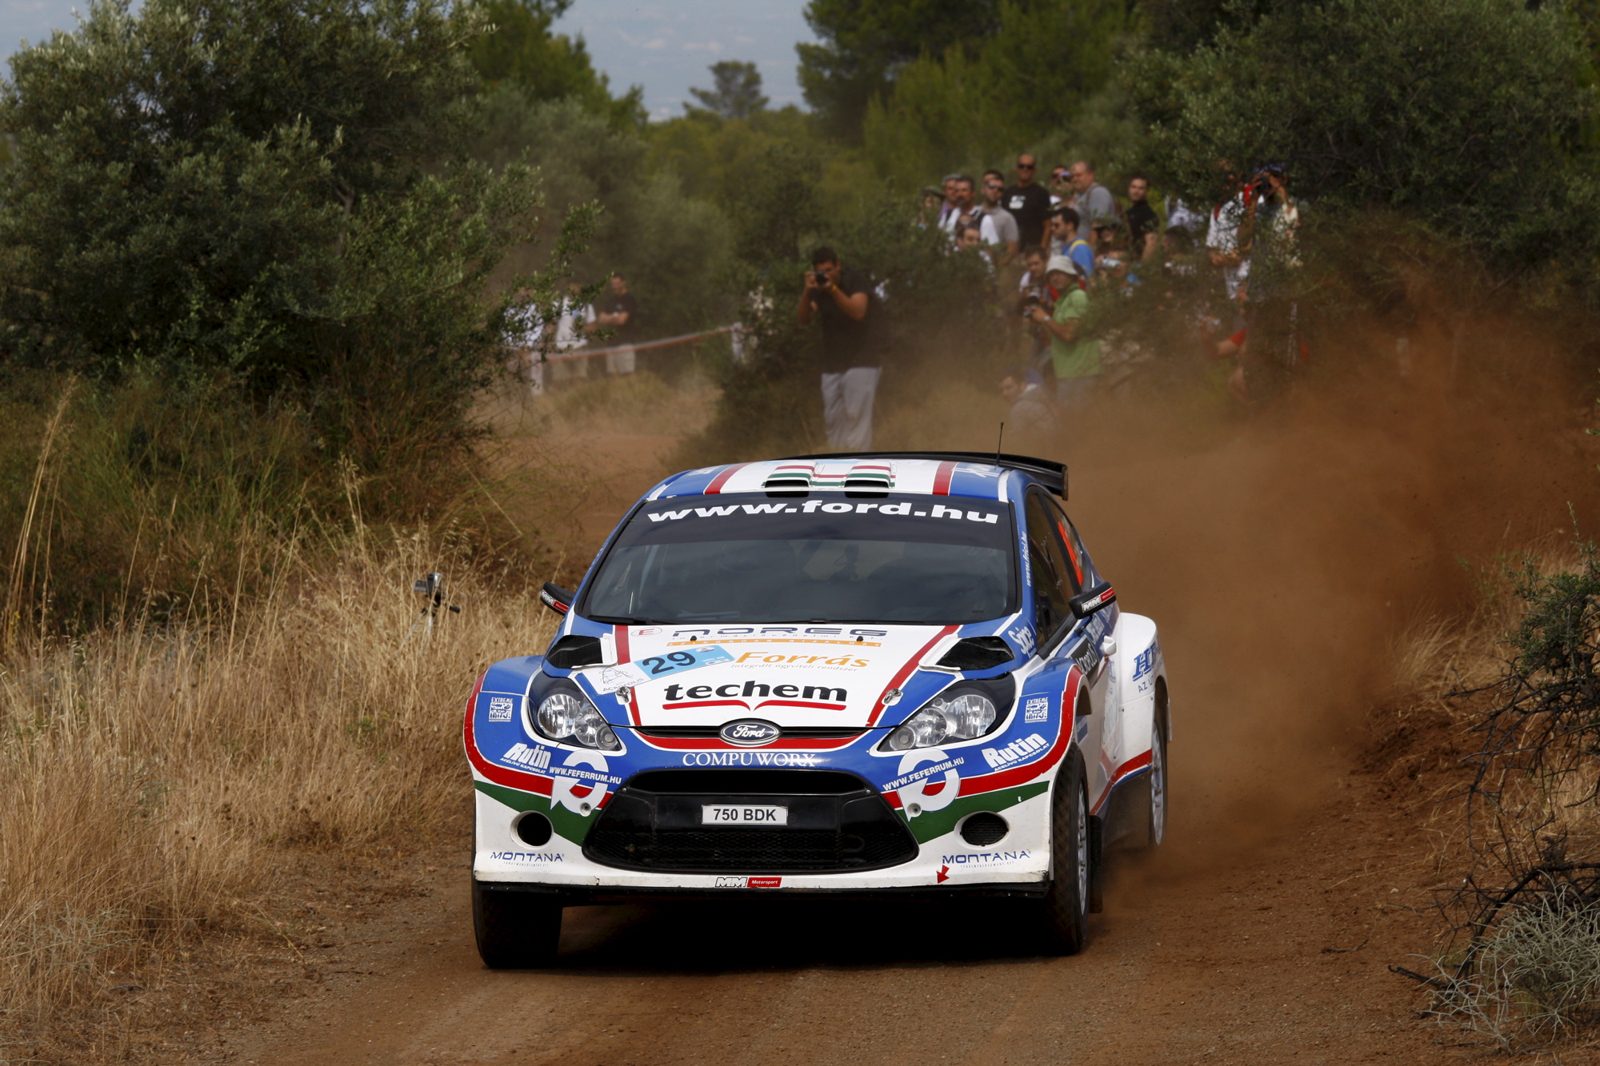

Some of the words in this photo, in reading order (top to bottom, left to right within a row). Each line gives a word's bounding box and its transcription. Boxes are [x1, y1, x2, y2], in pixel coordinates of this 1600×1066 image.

[647, 500, 999, 524] www.ford.hu
[642, 651, 696, 675] 29
[735, 651, 870, 668] Forrás
[663, 680, 848, 702] techem
[732, 724, 766, 738] Ford
[502, 742, 552, 770] Rutin
[981, 733, 1048, 769] Rutin
[549, 766, 623, 785] WWW.FEFERRUM.HU
[882, 756, 965, 792] WWW.FEFERRUM.HU
[713, 808, 739, 821] 750
[743, 808, 777, 821] BDK
[490, 851, 563, 862] MONTANA
[942, 850, 1031, 864] MONTANA
[715, 876, 747, 888] MM
